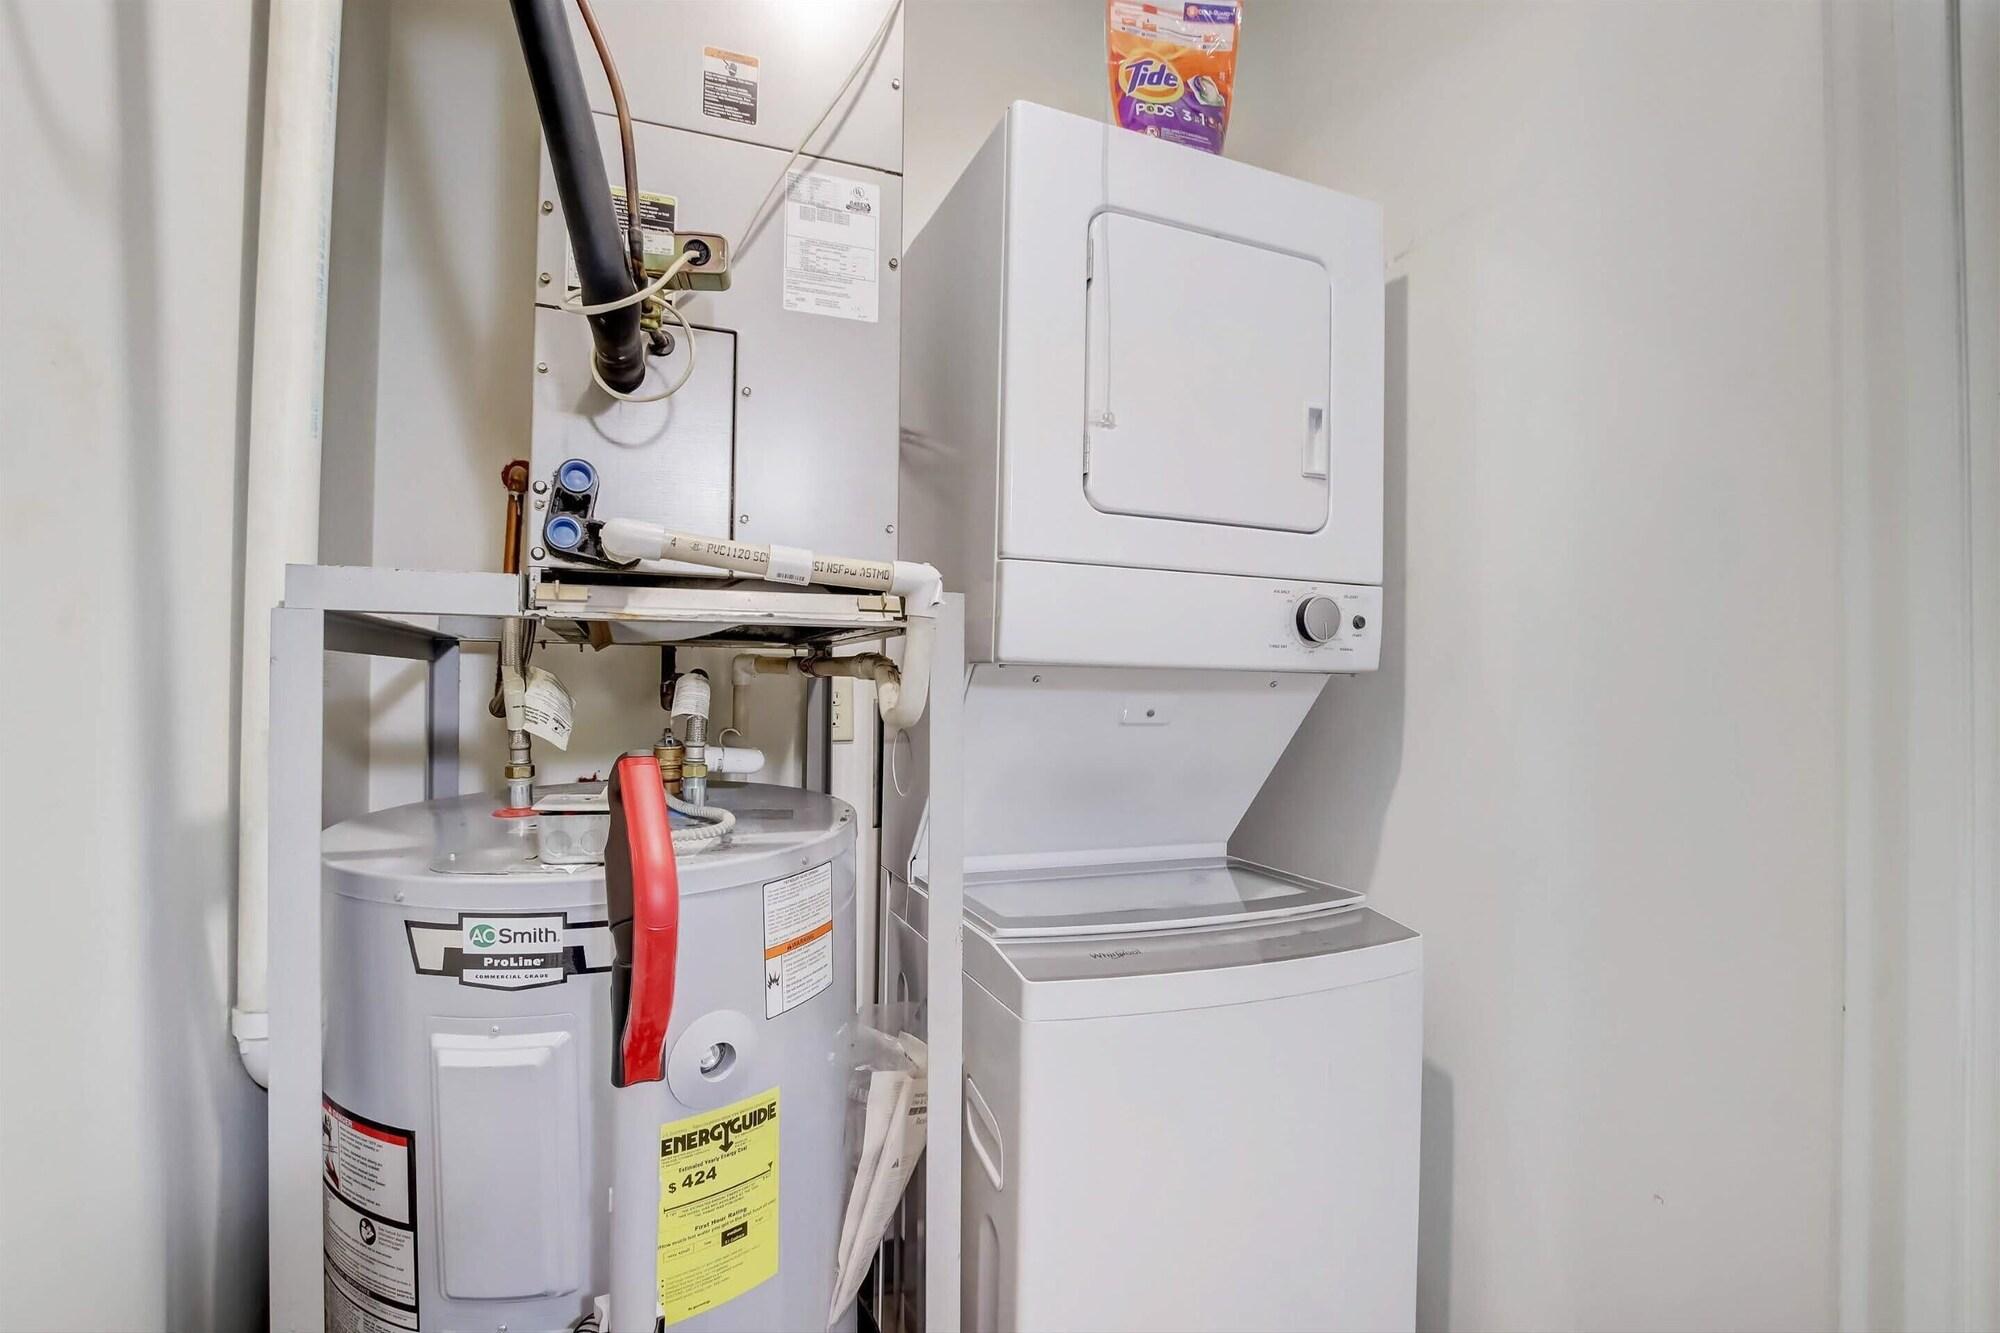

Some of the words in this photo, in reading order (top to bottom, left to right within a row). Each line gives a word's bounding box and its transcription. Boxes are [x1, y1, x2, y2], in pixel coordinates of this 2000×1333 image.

[1125, 60, 1177, 94] Tide
[1135, 103, 1175, 117] PODS
[1183, 110, 1192, 122] 3
[706, 543, 750, 560] PVC1120
[499, 928, 558, 944] Smith
[483, 957, 542, 967] ProLine
[661, 1101, 777, 1157] ENERGYGUIDE
[678, 1160, 704, 1174] Estimated
[705, 1155, 720, 1167] Yearly
[721, 1150, 737, 1162] Energy
[682, 1166, 717, 1188] 424
[694, 1219, 710, 1231] First
[711, 1213, 727, 1226] Hour
[728, 1207, 748, 1219] Rating
